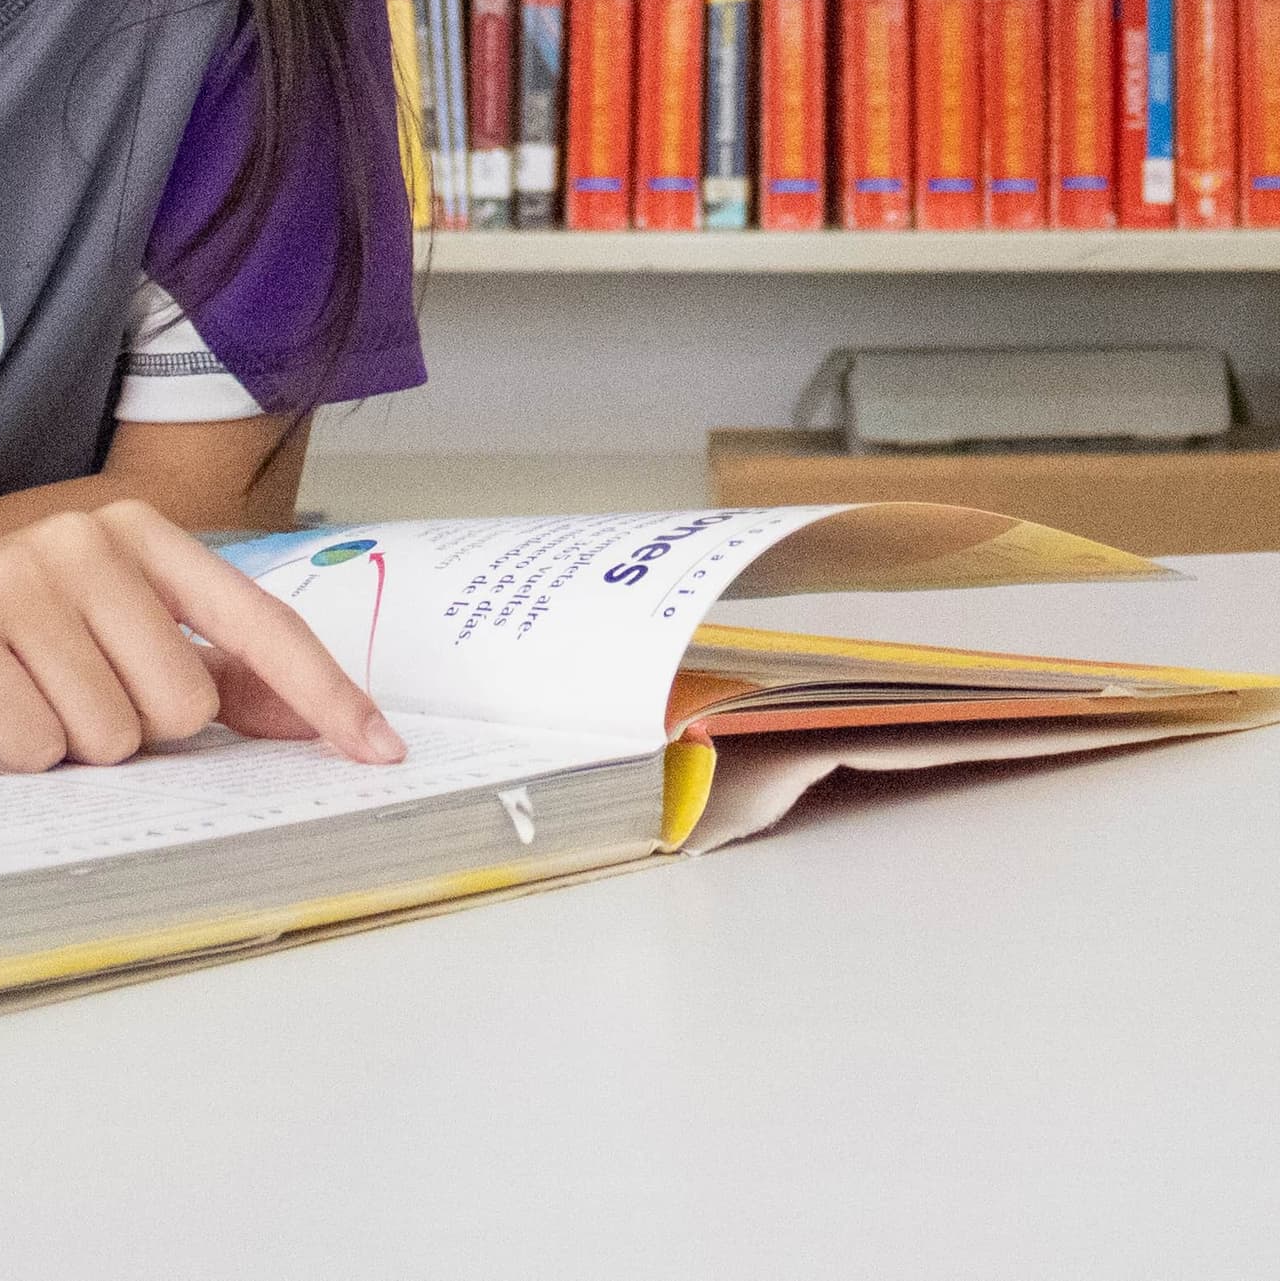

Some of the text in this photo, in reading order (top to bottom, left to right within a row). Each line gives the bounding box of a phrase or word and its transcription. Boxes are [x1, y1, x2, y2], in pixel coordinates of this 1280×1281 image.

[462, 575, 488, 595] de
[490, 574, 515, 594] de
[493, 566, 552, 627] vueltas
[443, 600, 470, 617] la
[516, 595, 551, 640] alre-
